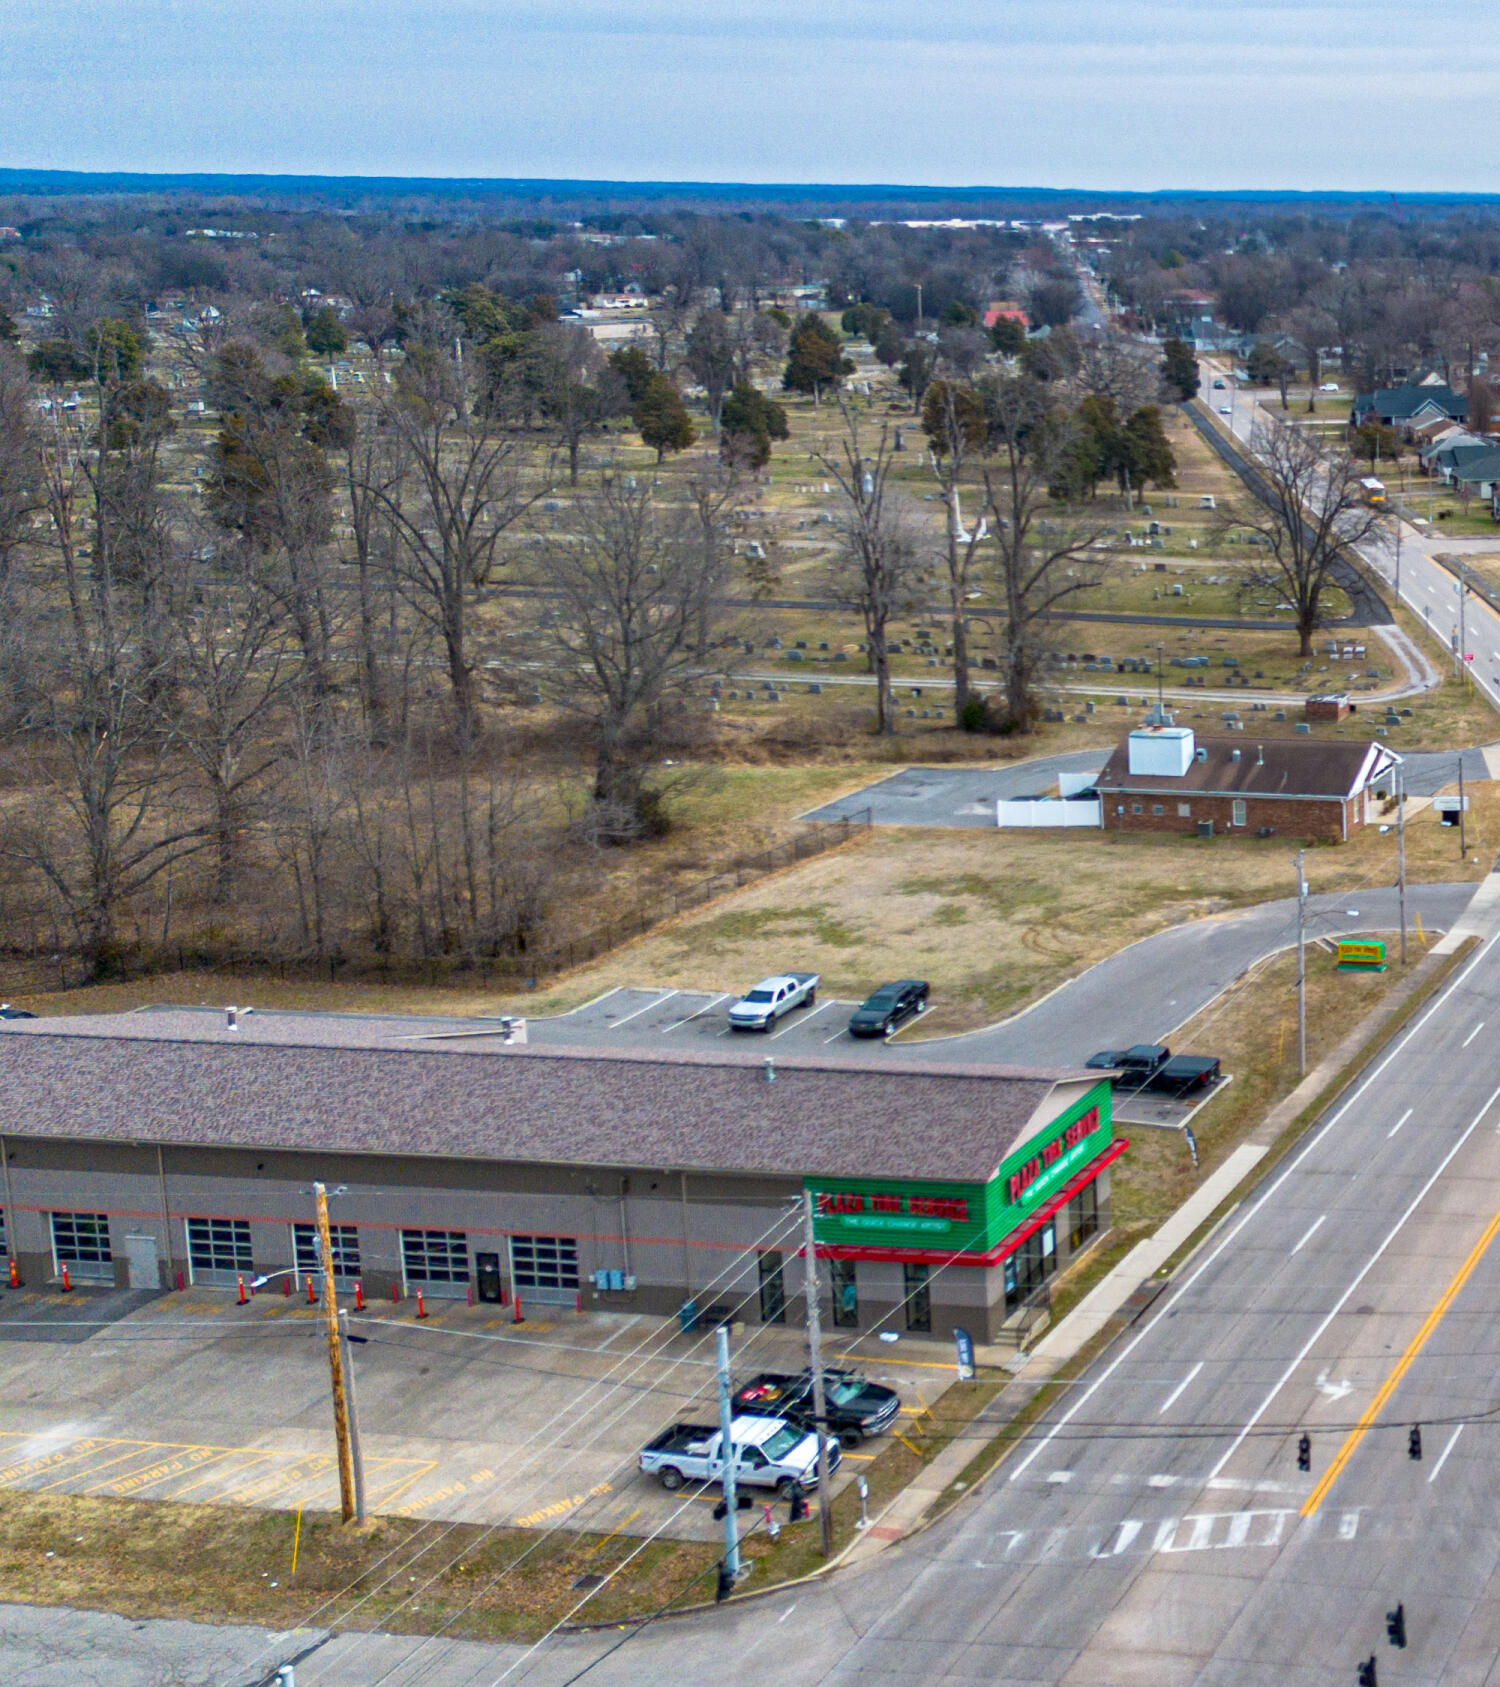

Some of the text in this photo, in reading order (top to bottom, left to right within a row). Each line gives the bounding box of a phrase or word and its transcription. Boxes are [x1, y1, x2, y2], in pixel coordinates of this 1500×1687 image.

[817, 1192, 969, 1223] PLAZA TIRE SERVICE
